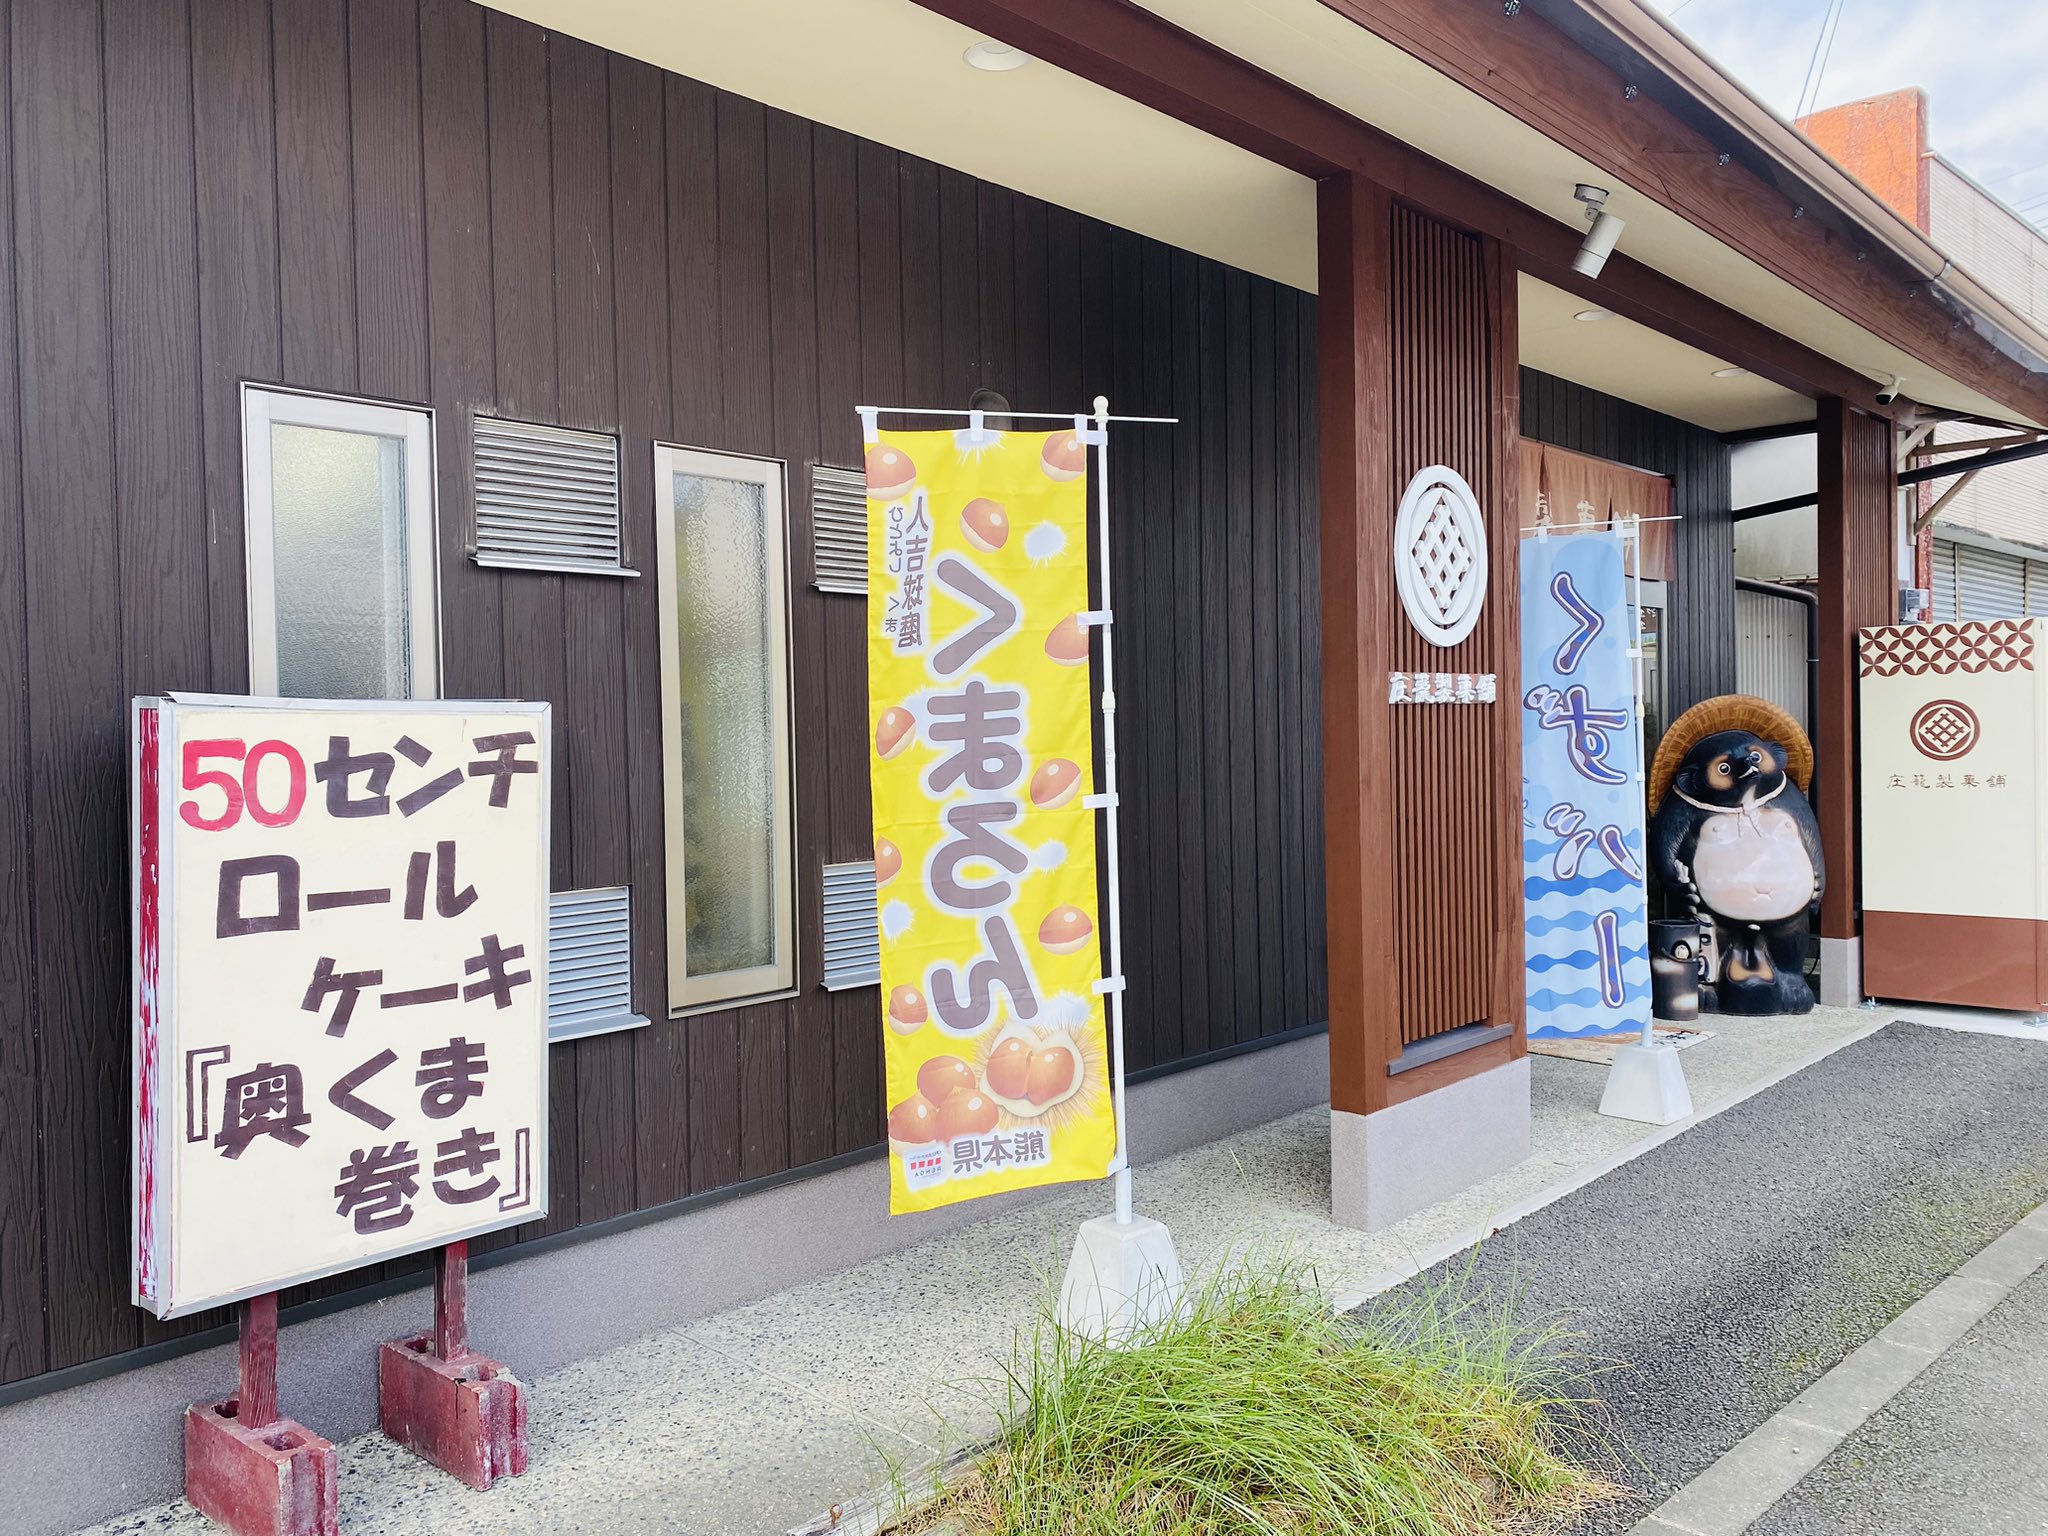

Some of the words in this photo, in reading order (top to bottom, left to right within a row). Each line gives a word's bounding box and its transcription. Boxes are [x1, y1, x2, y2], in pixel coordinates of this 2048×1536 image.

[178, 730, 539, 832] 50センチ
[216, 840, 479, 939] ロール
[301, 934, 532, 1038] ケーキ
[185, 1037, 490, 1161] 『奥くま
[334, 1126, 530, 1236] 巻き』
